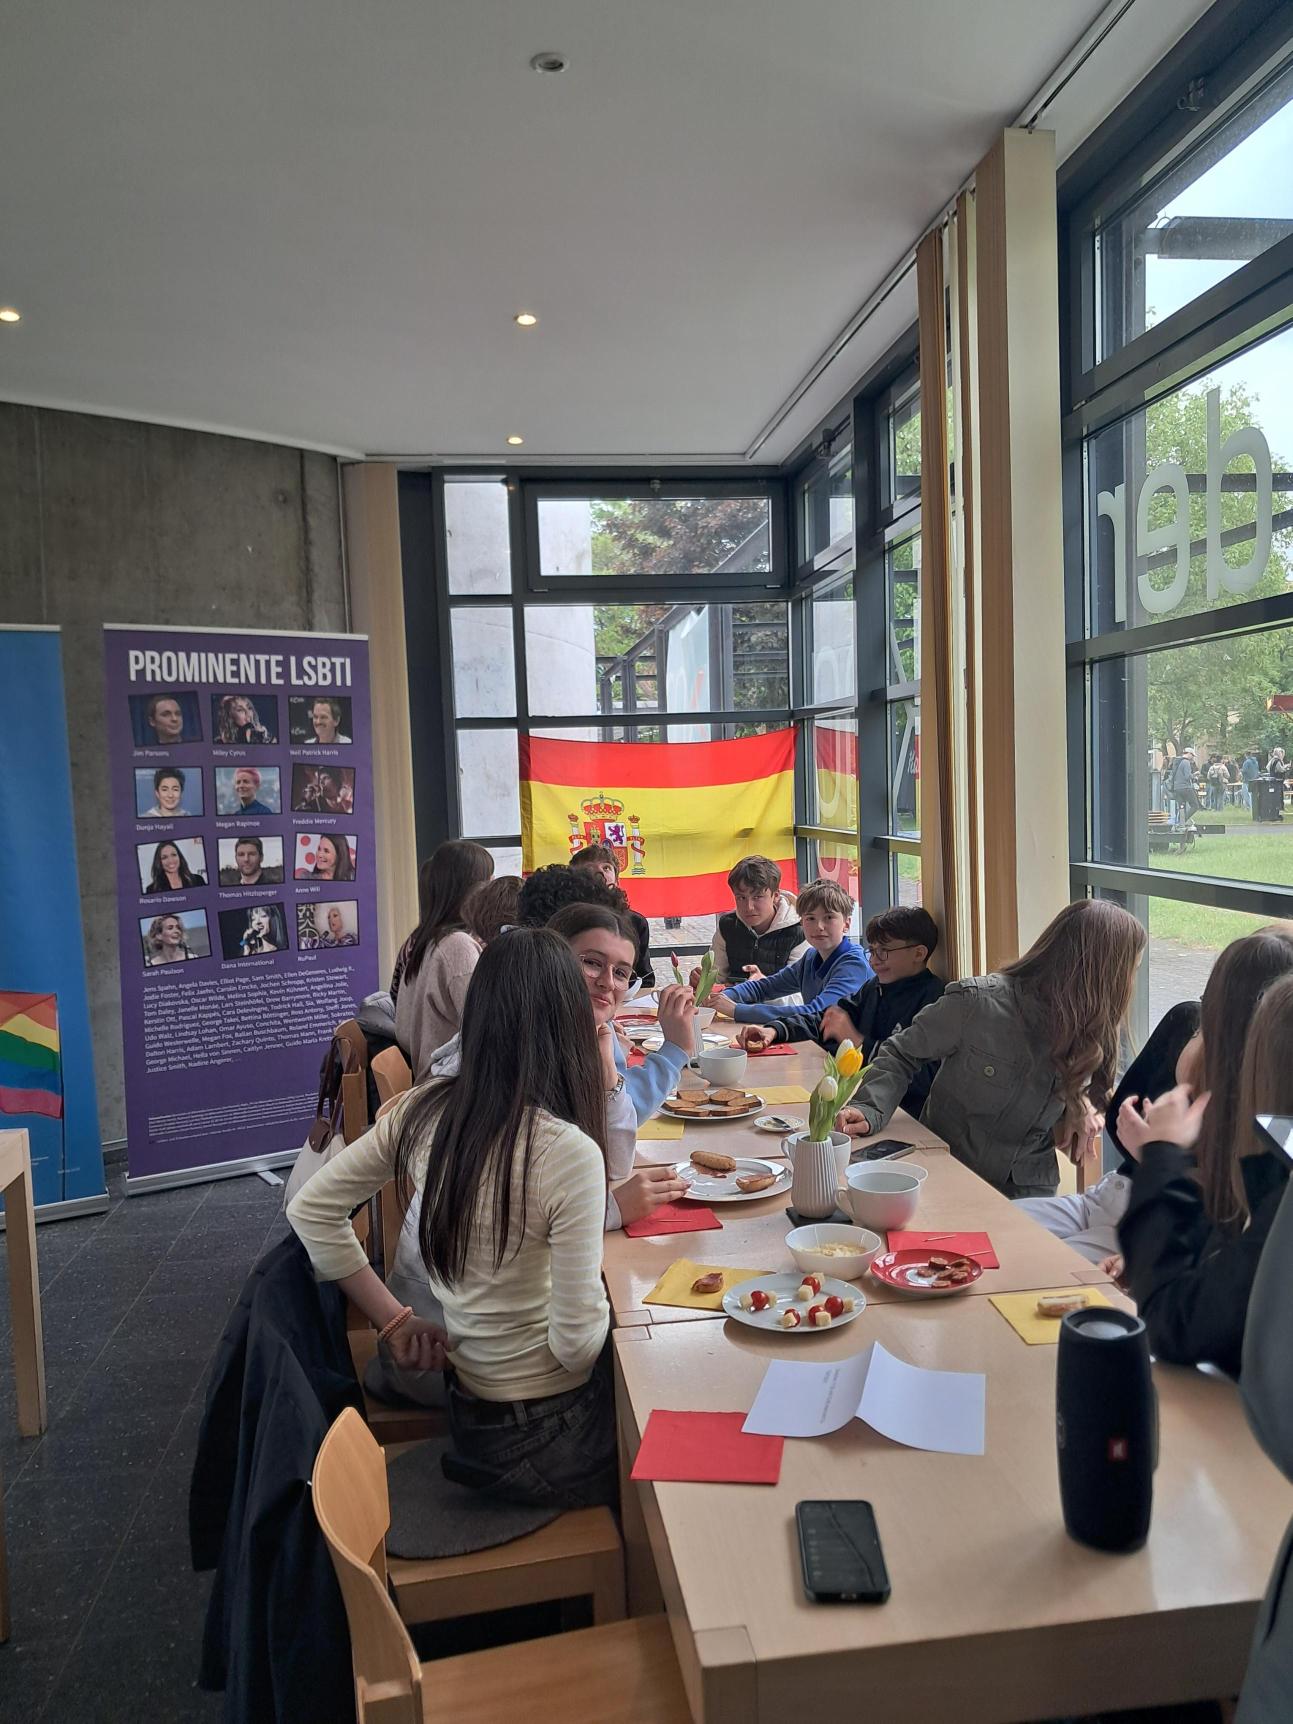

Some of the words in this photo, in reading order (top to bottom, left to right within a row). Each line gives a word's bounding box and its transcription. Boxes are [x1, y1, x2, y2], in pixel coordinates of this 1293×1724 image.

[128, 650, 284, 685] PROMINENTE
[290, 656, 352, 686] LSBTI
[216, 821, 235, 829] Megan
[236, 820, 260, 828] Rapinoe
[163, 895, 186, 903] Dawson
[237, 958, 274, 967] International
[160, 967, 184, 975] Paulson
